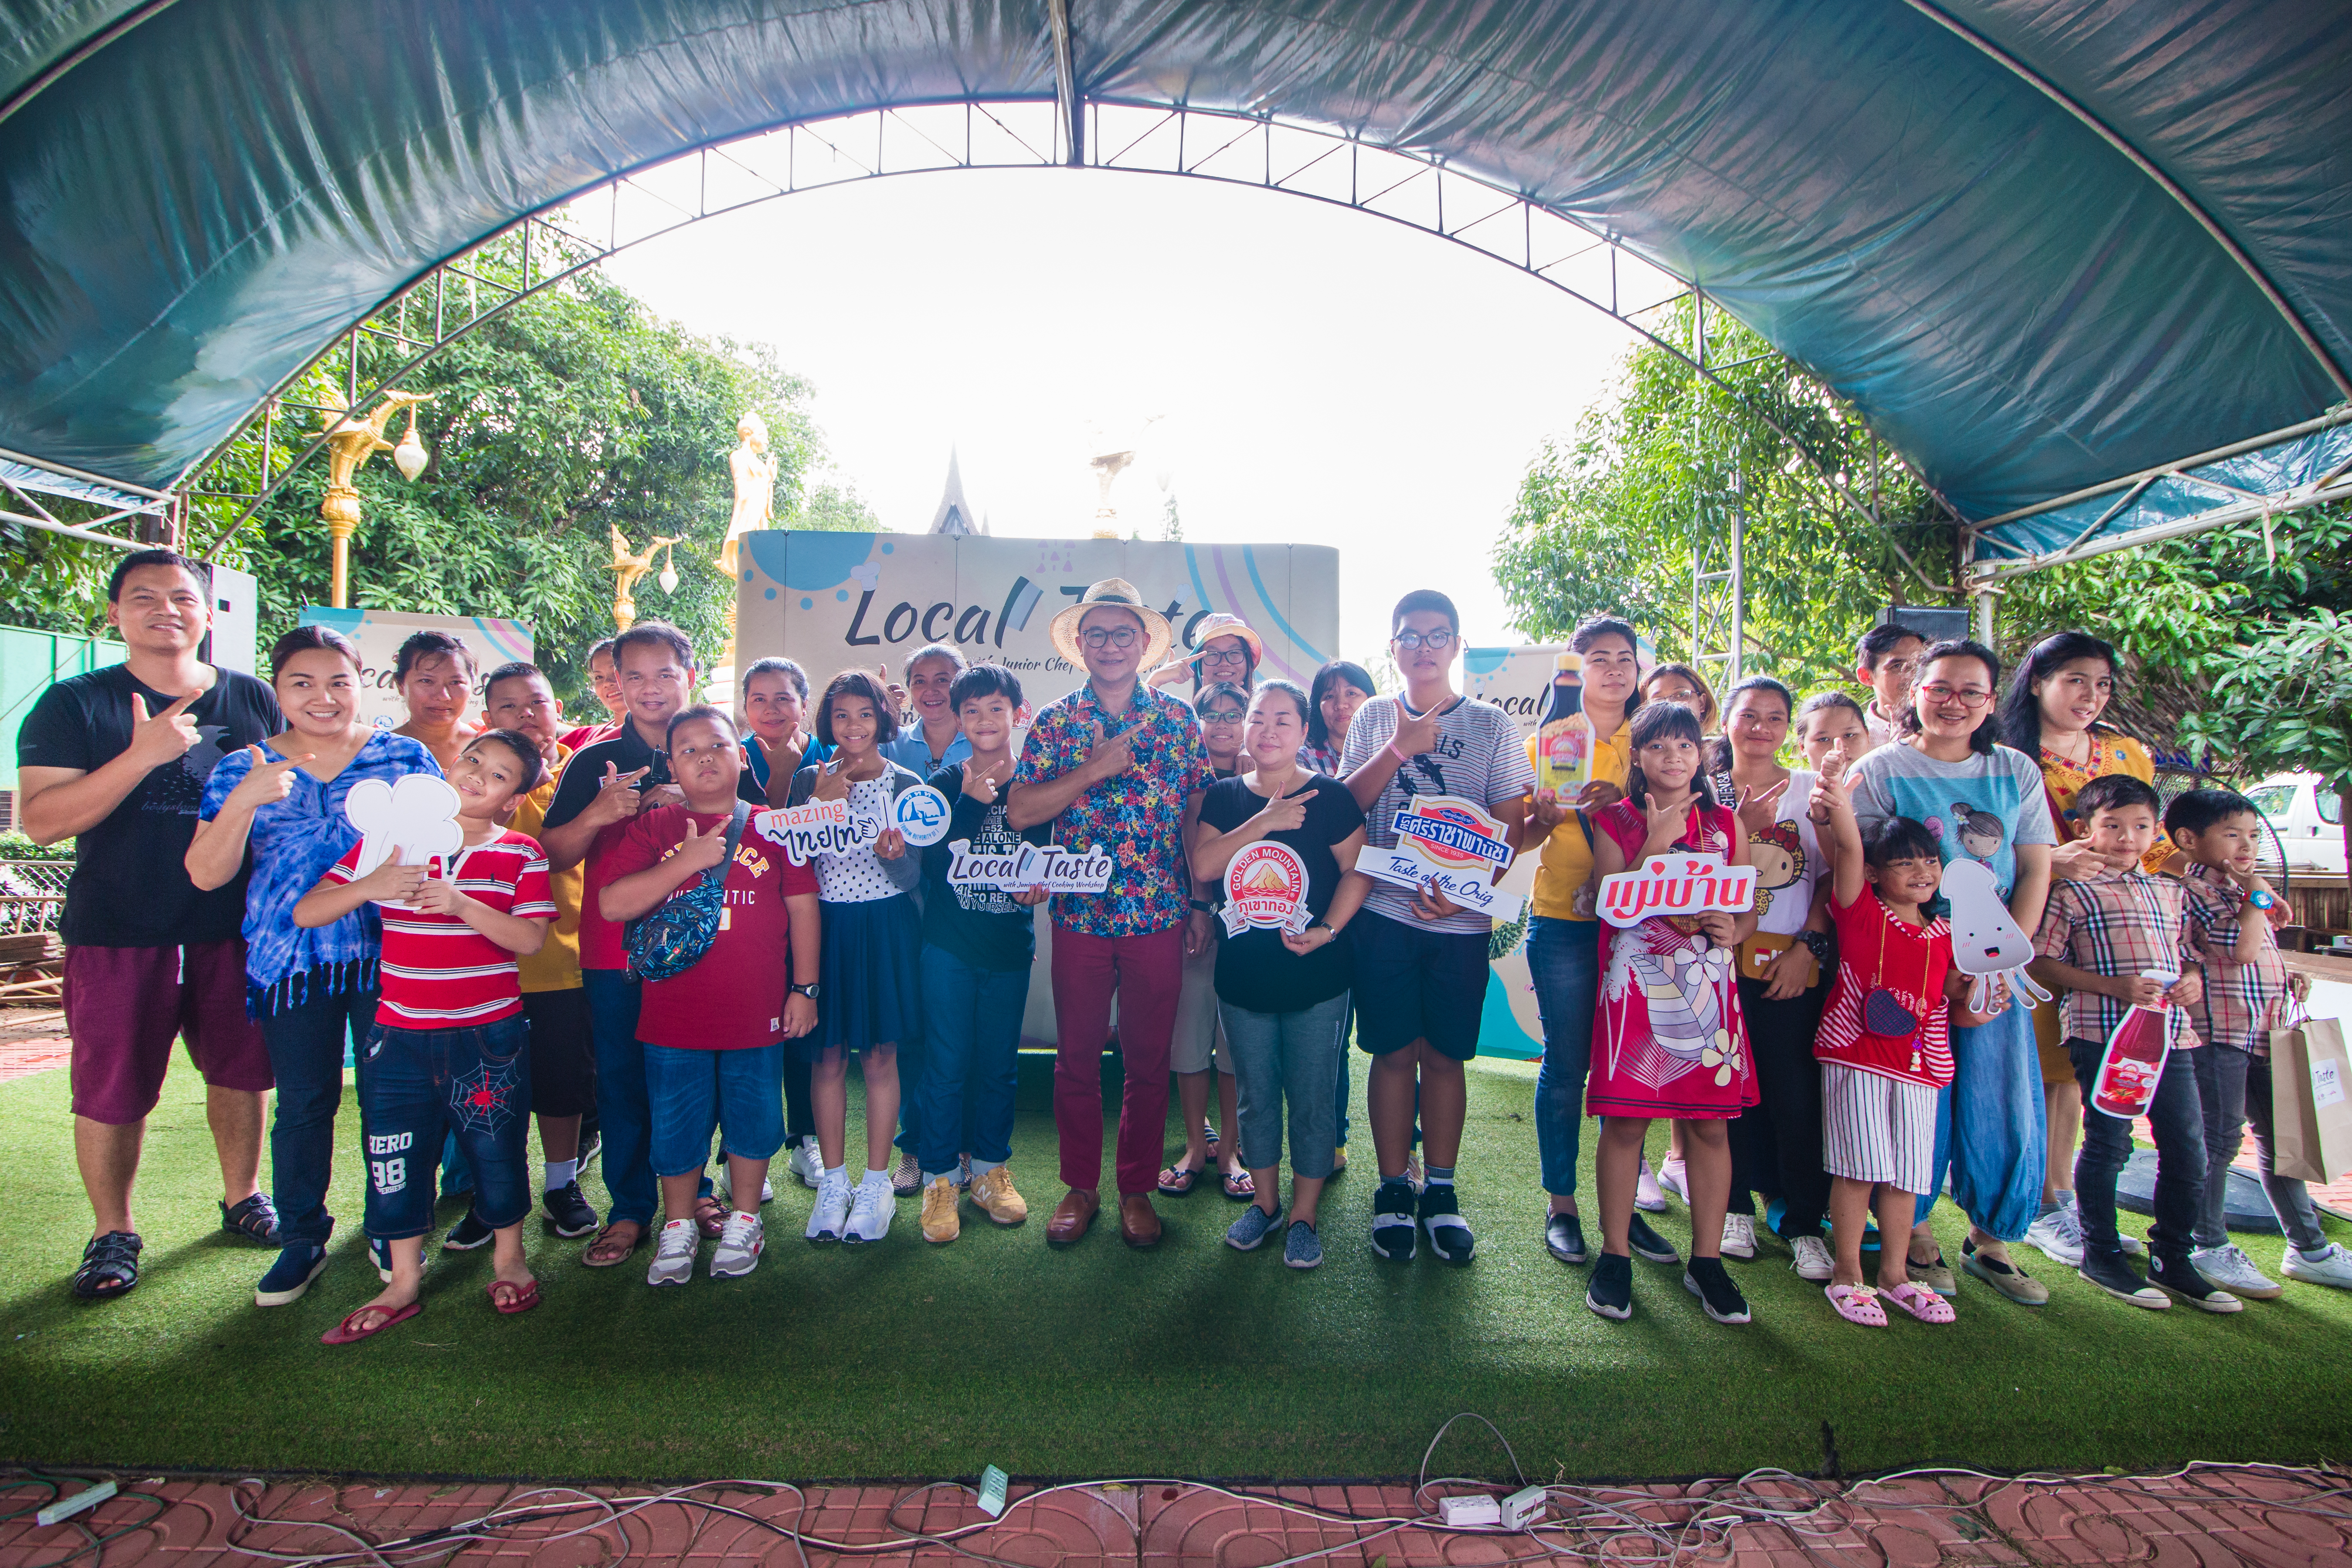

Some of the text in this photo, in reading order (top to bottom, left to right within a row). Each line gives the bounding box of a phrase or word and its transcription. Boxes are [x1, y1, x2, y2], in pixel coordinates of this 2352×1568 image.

[845, 576, 1033, 649] Local
[771, 803, 846, 828] mazing
[900, 823, 912, 837] TOURISM
[983, 832, 1020, 843] ALONE
[952, 847, 1109, 880] Local Taste
[1430, 844, 1464, 858] SINCE 1935
[1233, 848, 1301, 893] GOLDEN MOUNTAIN
[1389, 856, 1418, 878] Taste
[1438, 874, 1457, 890] the
[1459, 881, 1494, 908] Orig
[1052, 881, 1074, 890] Cooking
[1605, 860, 1748, 919] แม่บ้าน
[1238, 900, 1294, 915] ภูเขาทอง
[372, 1157, 406, 1187] 98
